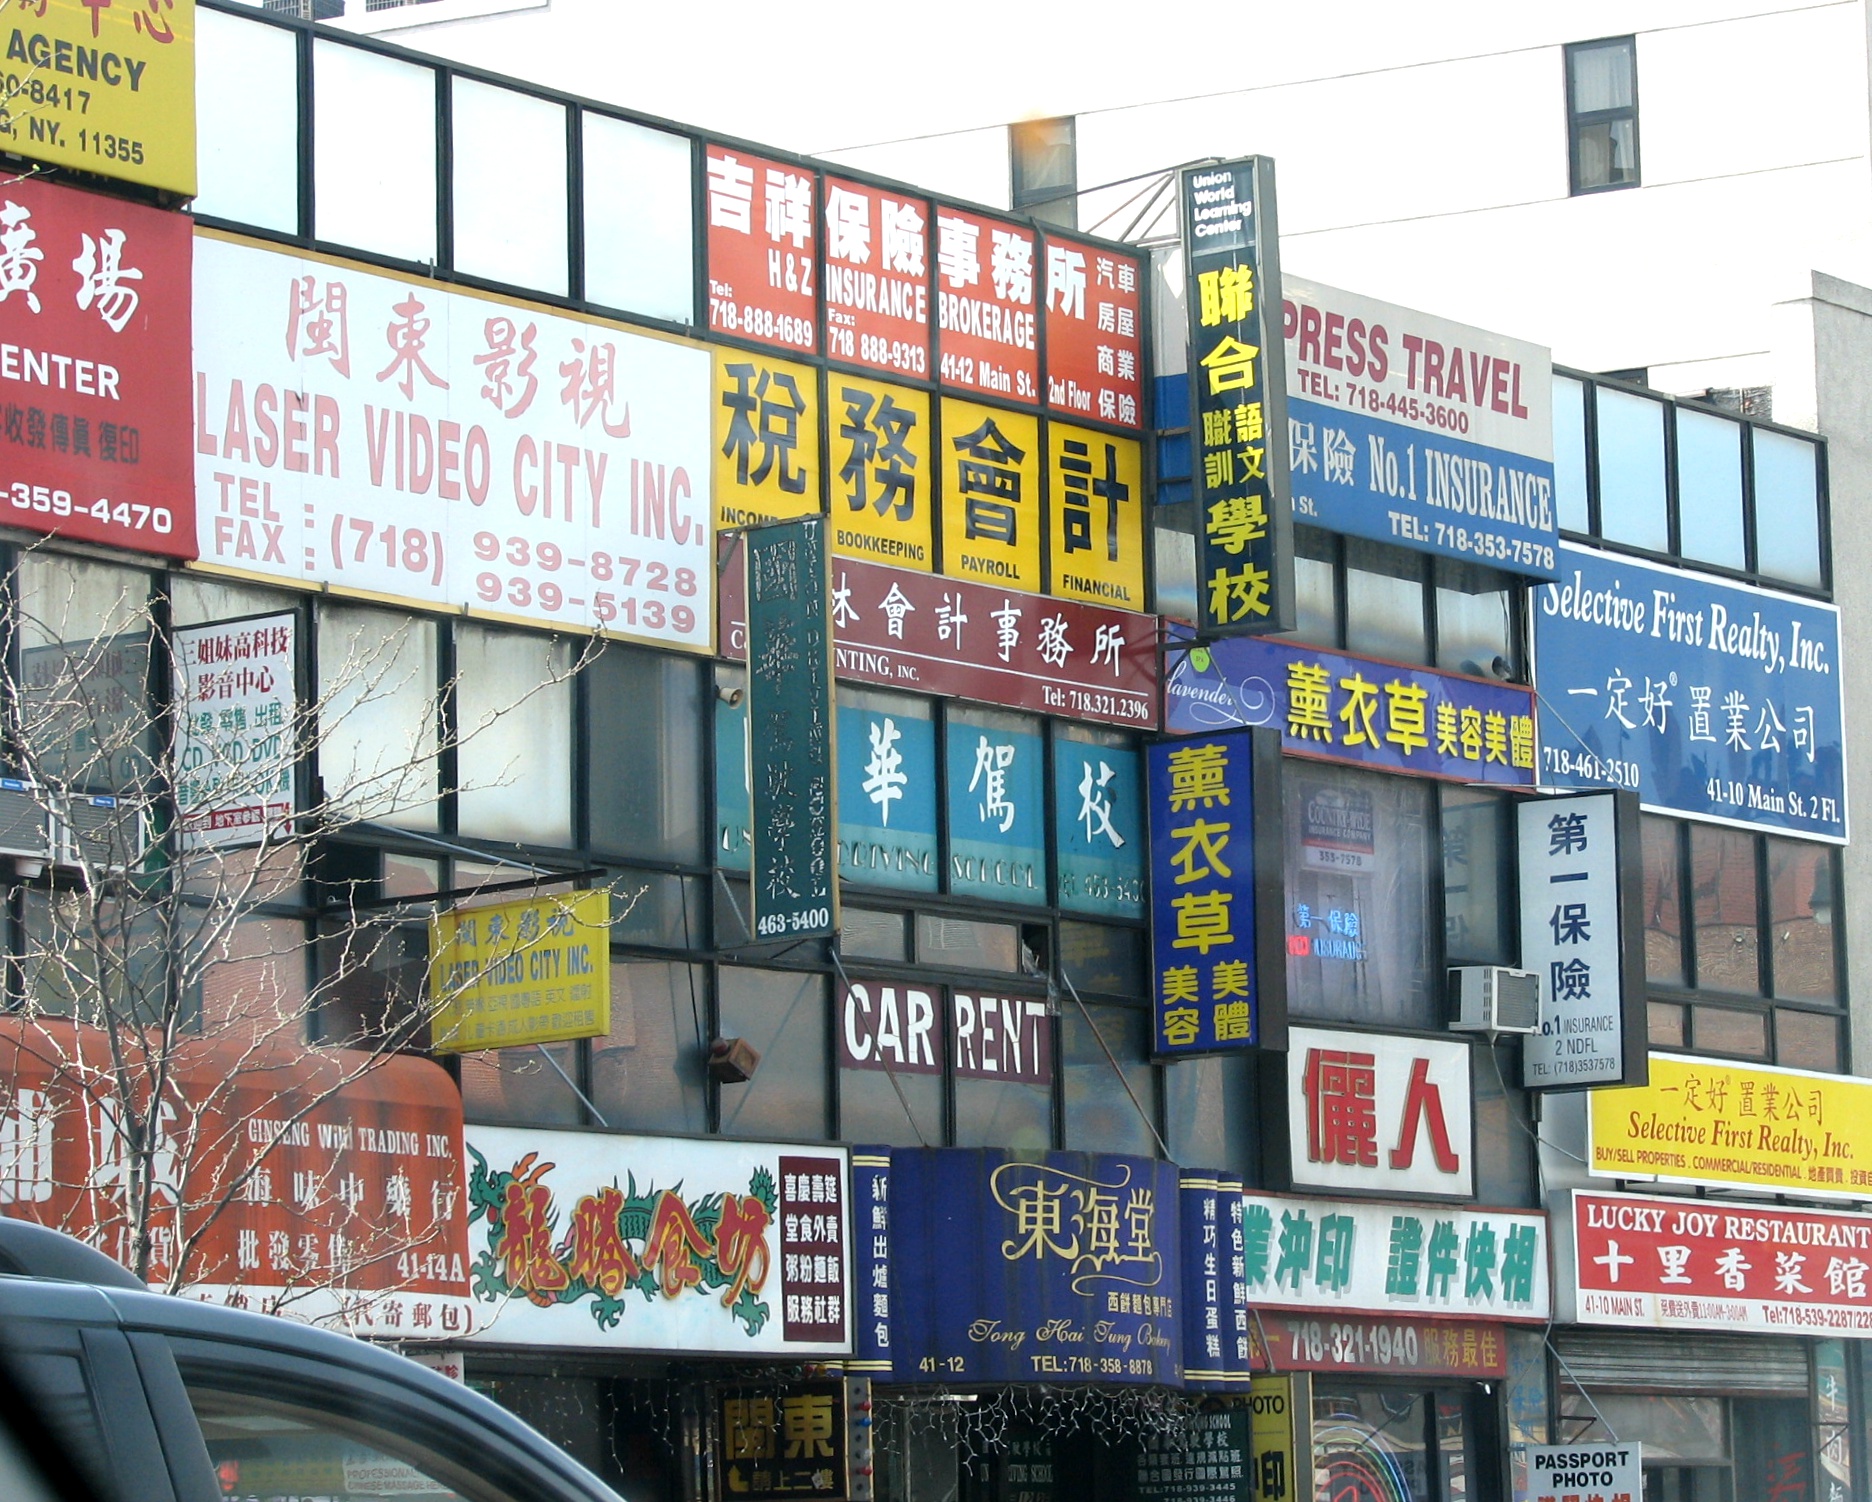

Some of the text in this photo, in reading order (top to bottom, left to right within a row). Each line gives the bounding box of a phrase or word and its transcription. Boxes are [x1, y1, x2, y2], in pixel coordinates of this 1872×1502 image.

[6, 28, 146, 92] AGENCY
[29, 116, 145, 165] NY. 11355
[1193, 170, 1232, 188] Union
[1194, 185, 1235, 205] World
[1194, 200, 1252, 221] Learning
[1195, 218, 1242, 238] Center
[707, 155, 1087, 321] 吉祥保險事務所
[710, 280, 733, 298] Tel:
[1097, 257, 1136, 294] 汽車
[710, 298, 813, 347] 718-888-1689
[826, 264, 926, 324] INSURANCE
[939, 293, 1035, 350] BROKERAGE
[828, 308, 856, 327] Fax:
[1098, 302, 1135, 338] 房屋
[829, 326, 925, 373] 718 888-9313
[1198, 264, 1260, 396] 聯合
[286, 275, 631, 438] 閩東影視
[940, 353, 1036, 397] 41-12 Main St.
[1097, 345, 1136, 382] 商業
[1402, 333, 1528, 419] TRAVEL
[1049, 375, 1091, 411] 2nd Floor
[1098, 388, 1137, 425] 保險
[1297, 368, 1469, 434] TEL: 718-445-3600
[197, 371, 704, 546] LASER VIDEO CITY INC.
[1202, 410, 1234, 489] 職訓
[1234, 402, 1266, 484] 語文
[1368, 434, 1553, 533] No.1 INSURANCE
[721, 506, 779, 527] INCOM
[1299, 495, 1318, 518] St.
[331, 513, 444, 586] (718)
[838, 530, 925, 561] BOOKKEEPING
[1206, 494, 1271, 625] 學校
[1388, 511, 1555, 570] TEL: 718-353-7578
[473, 531, 697, 597] 939-8728
[961, 554, 1020, 579] PAYROLL
[475, 572, 696, 634] 939-5139
[1063, 574, 1131, 601] FINANCIAL
[1543, 570, 1830, 675] Selective First Realty, Inc.
[198, 665, 275, 702] 影音中心
[897, 665, 920, 681] INC.
[1167, 660, 1235, 707] lavender
[1042, 685, 1148, 720] Tel: 718.321.2396
[1287, 660, 1534, 769] 薰衣草 美容美體
[1543, 747, 1640, 788] 718-461-2510
[1706, 777, 1841, 823] 41-10 Main St. 2 Fl.
[1168, 743, 1235, 954] 薰衣草
[758, 908, 829, 935] 463-5400
[1548, 812, 1591, 1002] 第一保險
[530, 948, 560, 980] CITY
[567, 943, 593, 976] INC.
[1163, 964, 1200, 1046] 美容
[1212, 959, 1250, 1041] 美體
[845, 984, 1045, 1075] CAR RENT
[1534, 1015, 1614, 1037] o.1 INSURANCE
[1555, 1039, 1562, 1056] 2
[1533, 1058, 1615, 1076] TEL: (718)3537578
[249, 1118, 310, 1147] GINSENG
[358, 1128, 419, 1156] TRADING
[427, 1133, 453, 1159] INC.
[1627, 1111, 1854, 1161] Selective First Realty, Inc.
[1596, 1146, 1801, 1179] BUY/SELL PROPERTIES COMMERCIAL/RESIDENTIAL
[785, 1213, 838, 1243] 堂食外賣
[1587, 1204, 1871, 1249] LUCKY JOY RESTAURANT
[786, 1254, 839, 1284] 粥粉麵飯
[1203, 1198, 1221, 1358] 精巧生日蛋糕
[1385, 1216, 1537, 1302] 證件快相
[1593, 1239, 1870, 1299] 十里香菜館
[787, 1295, 840, 1325] 服務社群
[1585, 1295, 1645, 1317] 41-10 MAIN ST.
[968, 1319, 1026, 1351] Tong
[1036, 1318, 1085, 1344] Hai
[1093, 1320, 1132, 1353] Tung
[1288, 1320, 1418, 1366] 718-321-1940
[723, 1393, 835, 1461] 閩東
[1535, 1451, 1629, 1469] PASSPORT
[1552, 1472, 1613, 1488] PHOTO
